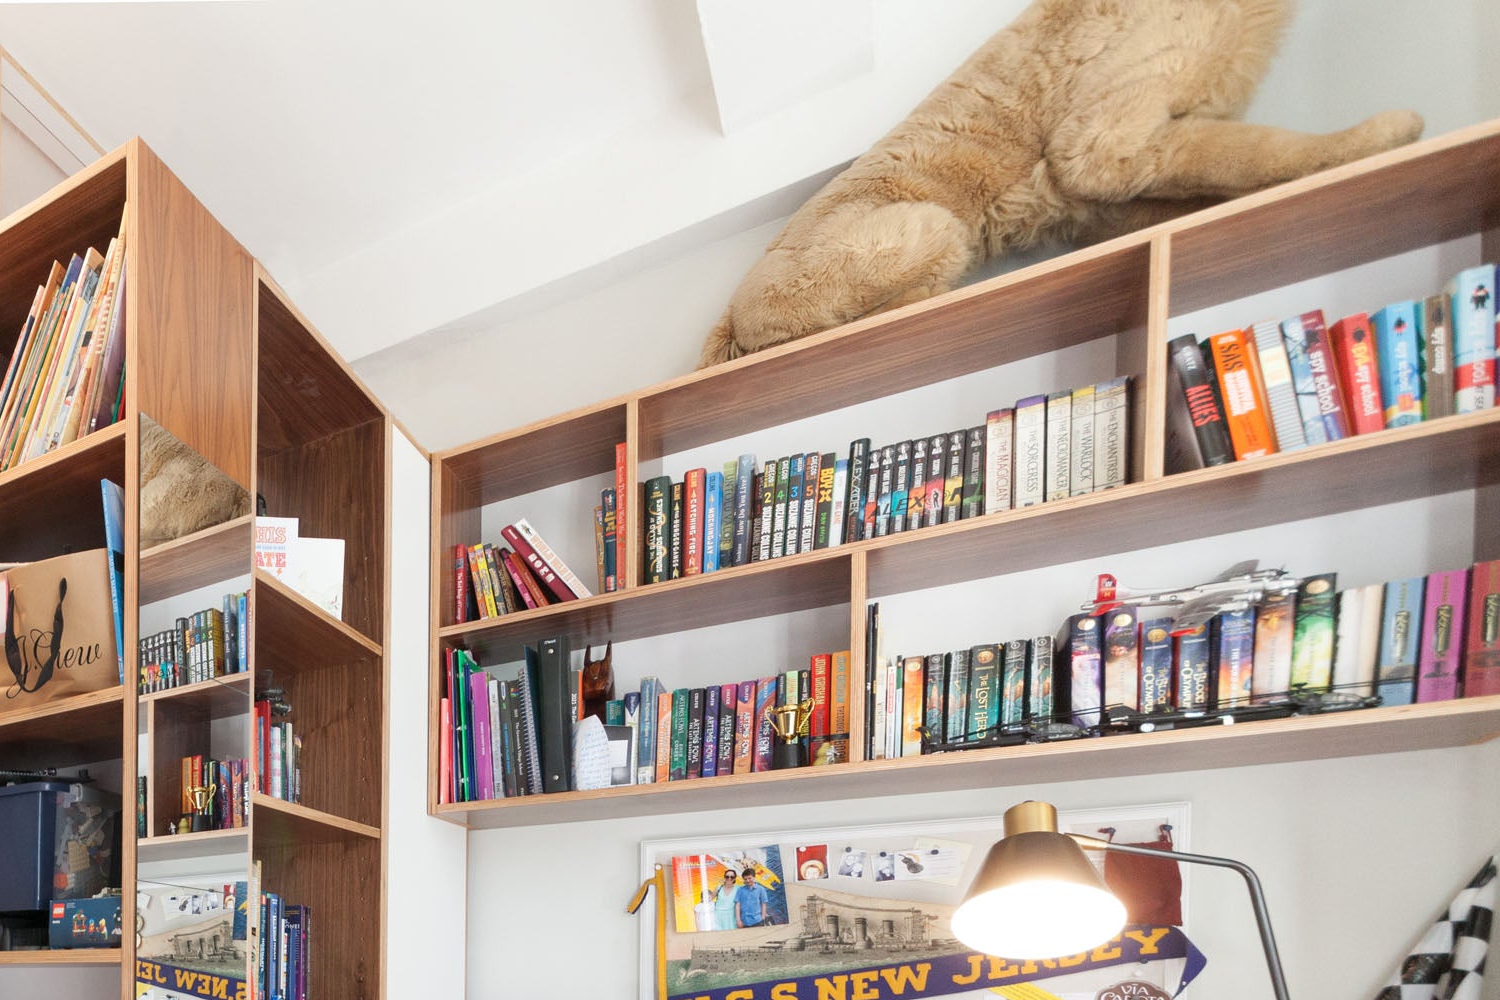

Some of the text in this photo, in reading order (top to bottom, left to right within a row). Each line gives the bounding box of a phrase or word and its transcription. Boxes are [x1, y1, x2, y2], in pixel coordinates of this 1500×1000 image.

[1220, 343, 1244, 372] SAS
[1310, 350, 1326, 372] spy
[1186, 383, 1220, 427] ALLIES
[1315, 374, 1340, 416] school
[1027, 441, 1038, 493] SORCERESS
[1056, 433, 1069, 489] NECROMANCER
[1080, 435, 1092, 482] WARLOCK
[1107, 421, 1118, 482] ENCHANTRESS
[777, 490, 784, 500] 4
[791, 486, 798, 498] 3
[806, 485, 813, 496] 5
[819, 468, 834, 503] BOY X
[997, 454, 1010, 502] MAGICIAN
[764, 492, 771, 503] 2
[802, 499, 814, 528] SUZANNE
[760, 506, 772, 560] SUZANNE COLLINS
[772, 503, 786, 558] SUZANNE COLLINS
[786, 500, 799, 555] SUZANNE COLLINS
[6, 629, 102, 699] J.Cew
[815, 677, 826, 705] GRISHAM
[976, 687, 990, 709] LOST
[692, 719, 701, 743] ARTEMIS
[706, 716, 715, 742] ARTEMIS
[722, 715, 732, 760] ARTEMIS FOWL
[742, 712, 751, 737] ARTEMIS
